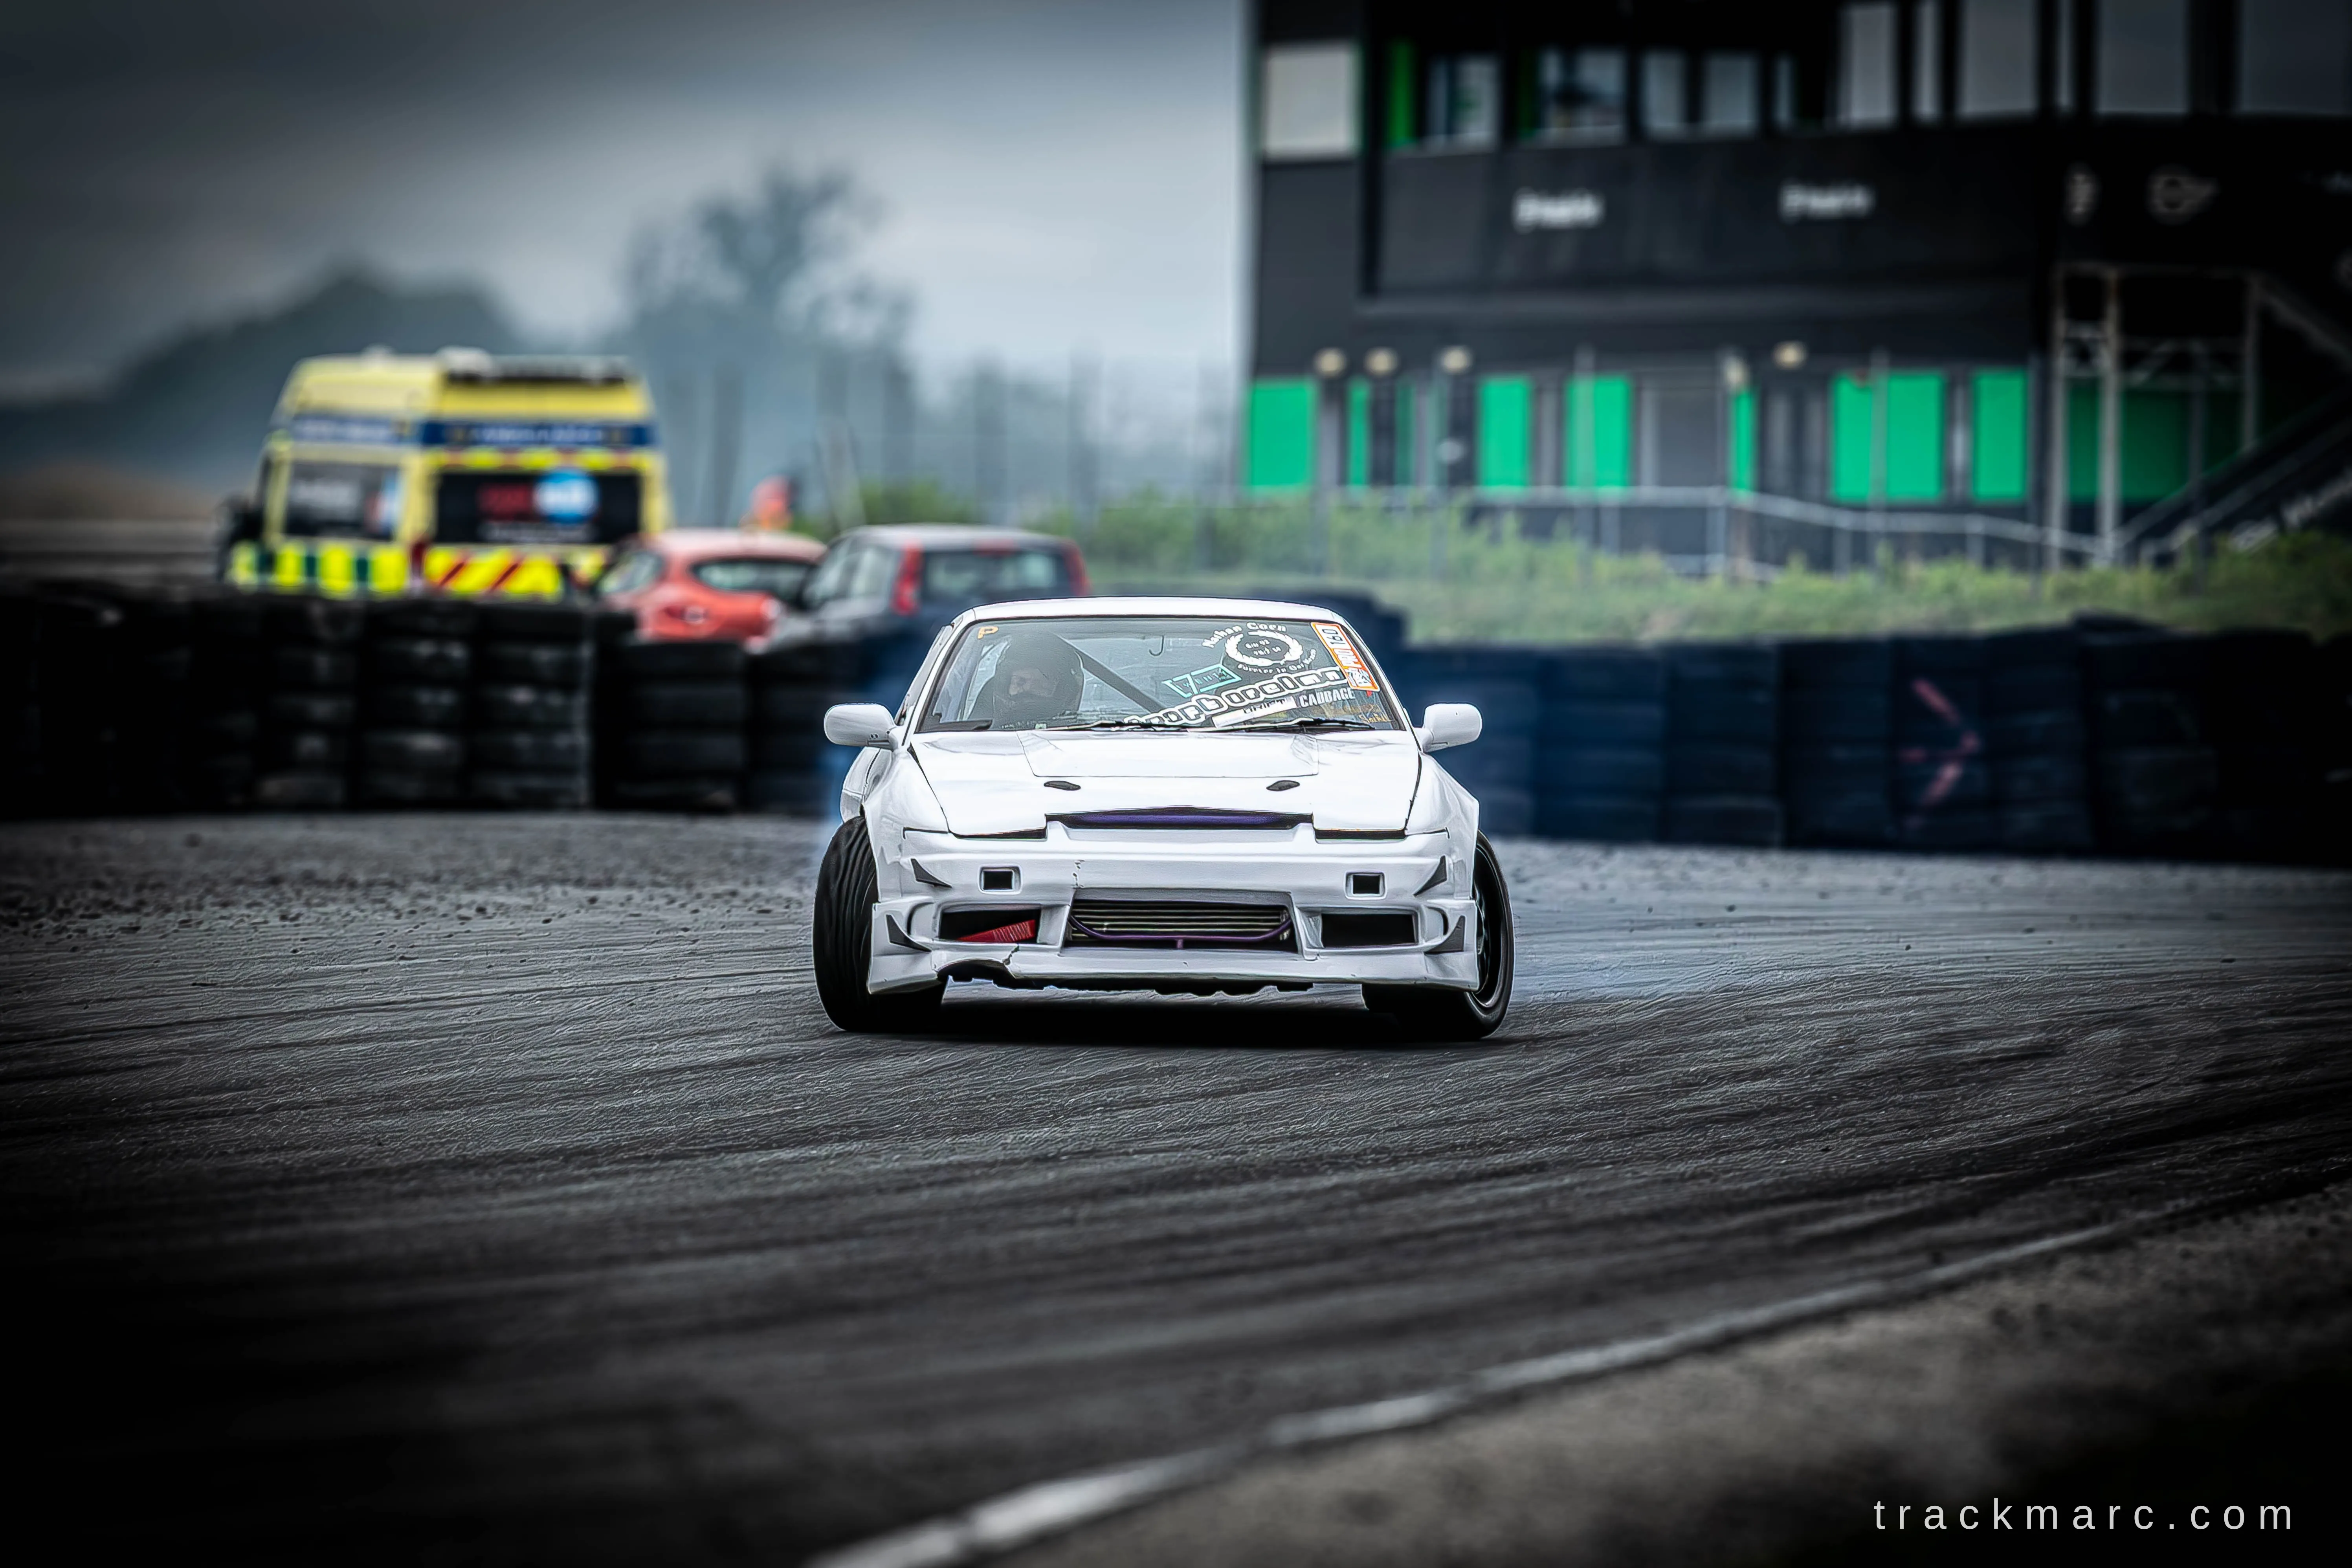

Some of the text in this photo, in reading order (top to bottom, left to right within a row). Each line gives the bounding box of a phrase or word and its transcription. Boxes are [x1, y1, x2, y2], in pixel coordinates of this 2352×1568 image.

[1202, 625, 1242, 648] Nathan
[1321, 629, 1346, 645] 160
[1334, 648, 1362, 668] PRO
[1299, 687, 1356, 708] CABBAGE
